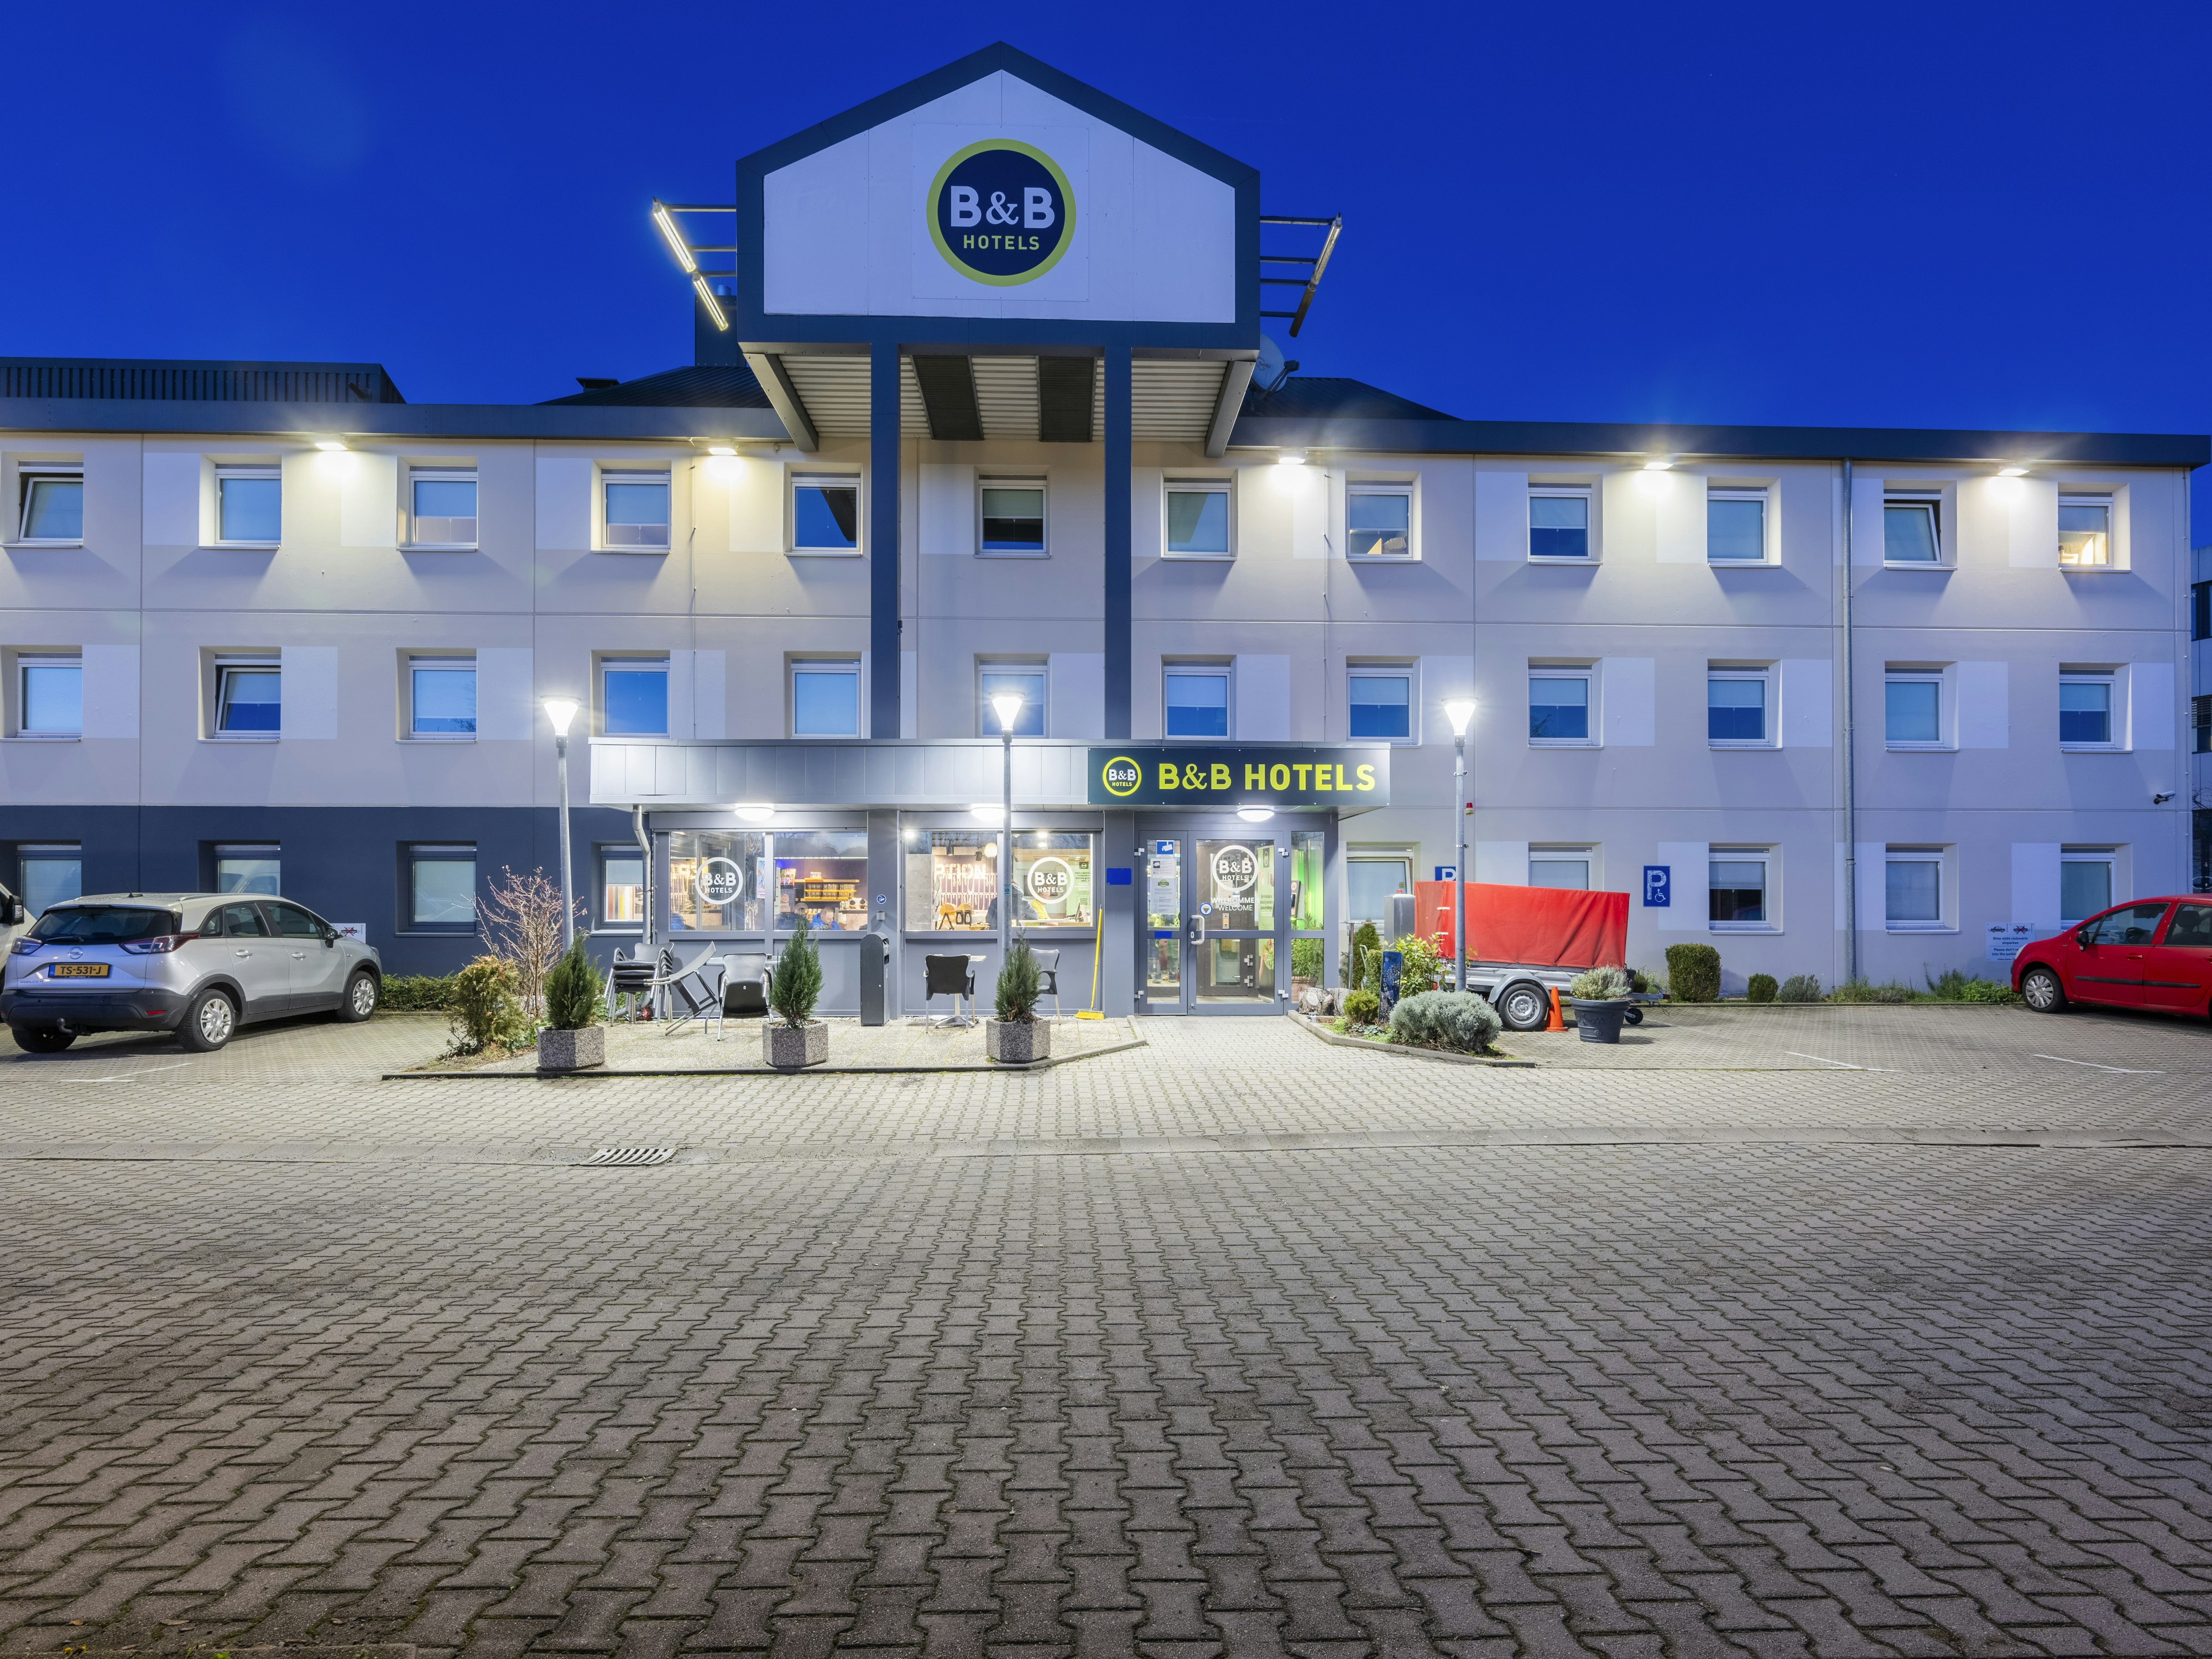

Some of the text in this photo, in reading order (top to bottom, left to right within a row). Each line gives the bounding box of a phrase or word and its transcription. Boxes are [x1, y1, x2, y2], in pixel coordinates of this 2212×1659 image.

[951, 186, 1055, 228] B&B
[963, 234, 1040, 250] HOTELS
[1109, 769, 1136, 781] B&B
[1159, 763, 1375, 791] B&B HOTELS
[1219, 860, 1252, 874] B&B
[703, 872, 736, 886] B&B
[1035, 872, 1067, 886] B&B
[1647, 870, 1667, 900] P
[60, 966, 101, 974] TS-531-J
